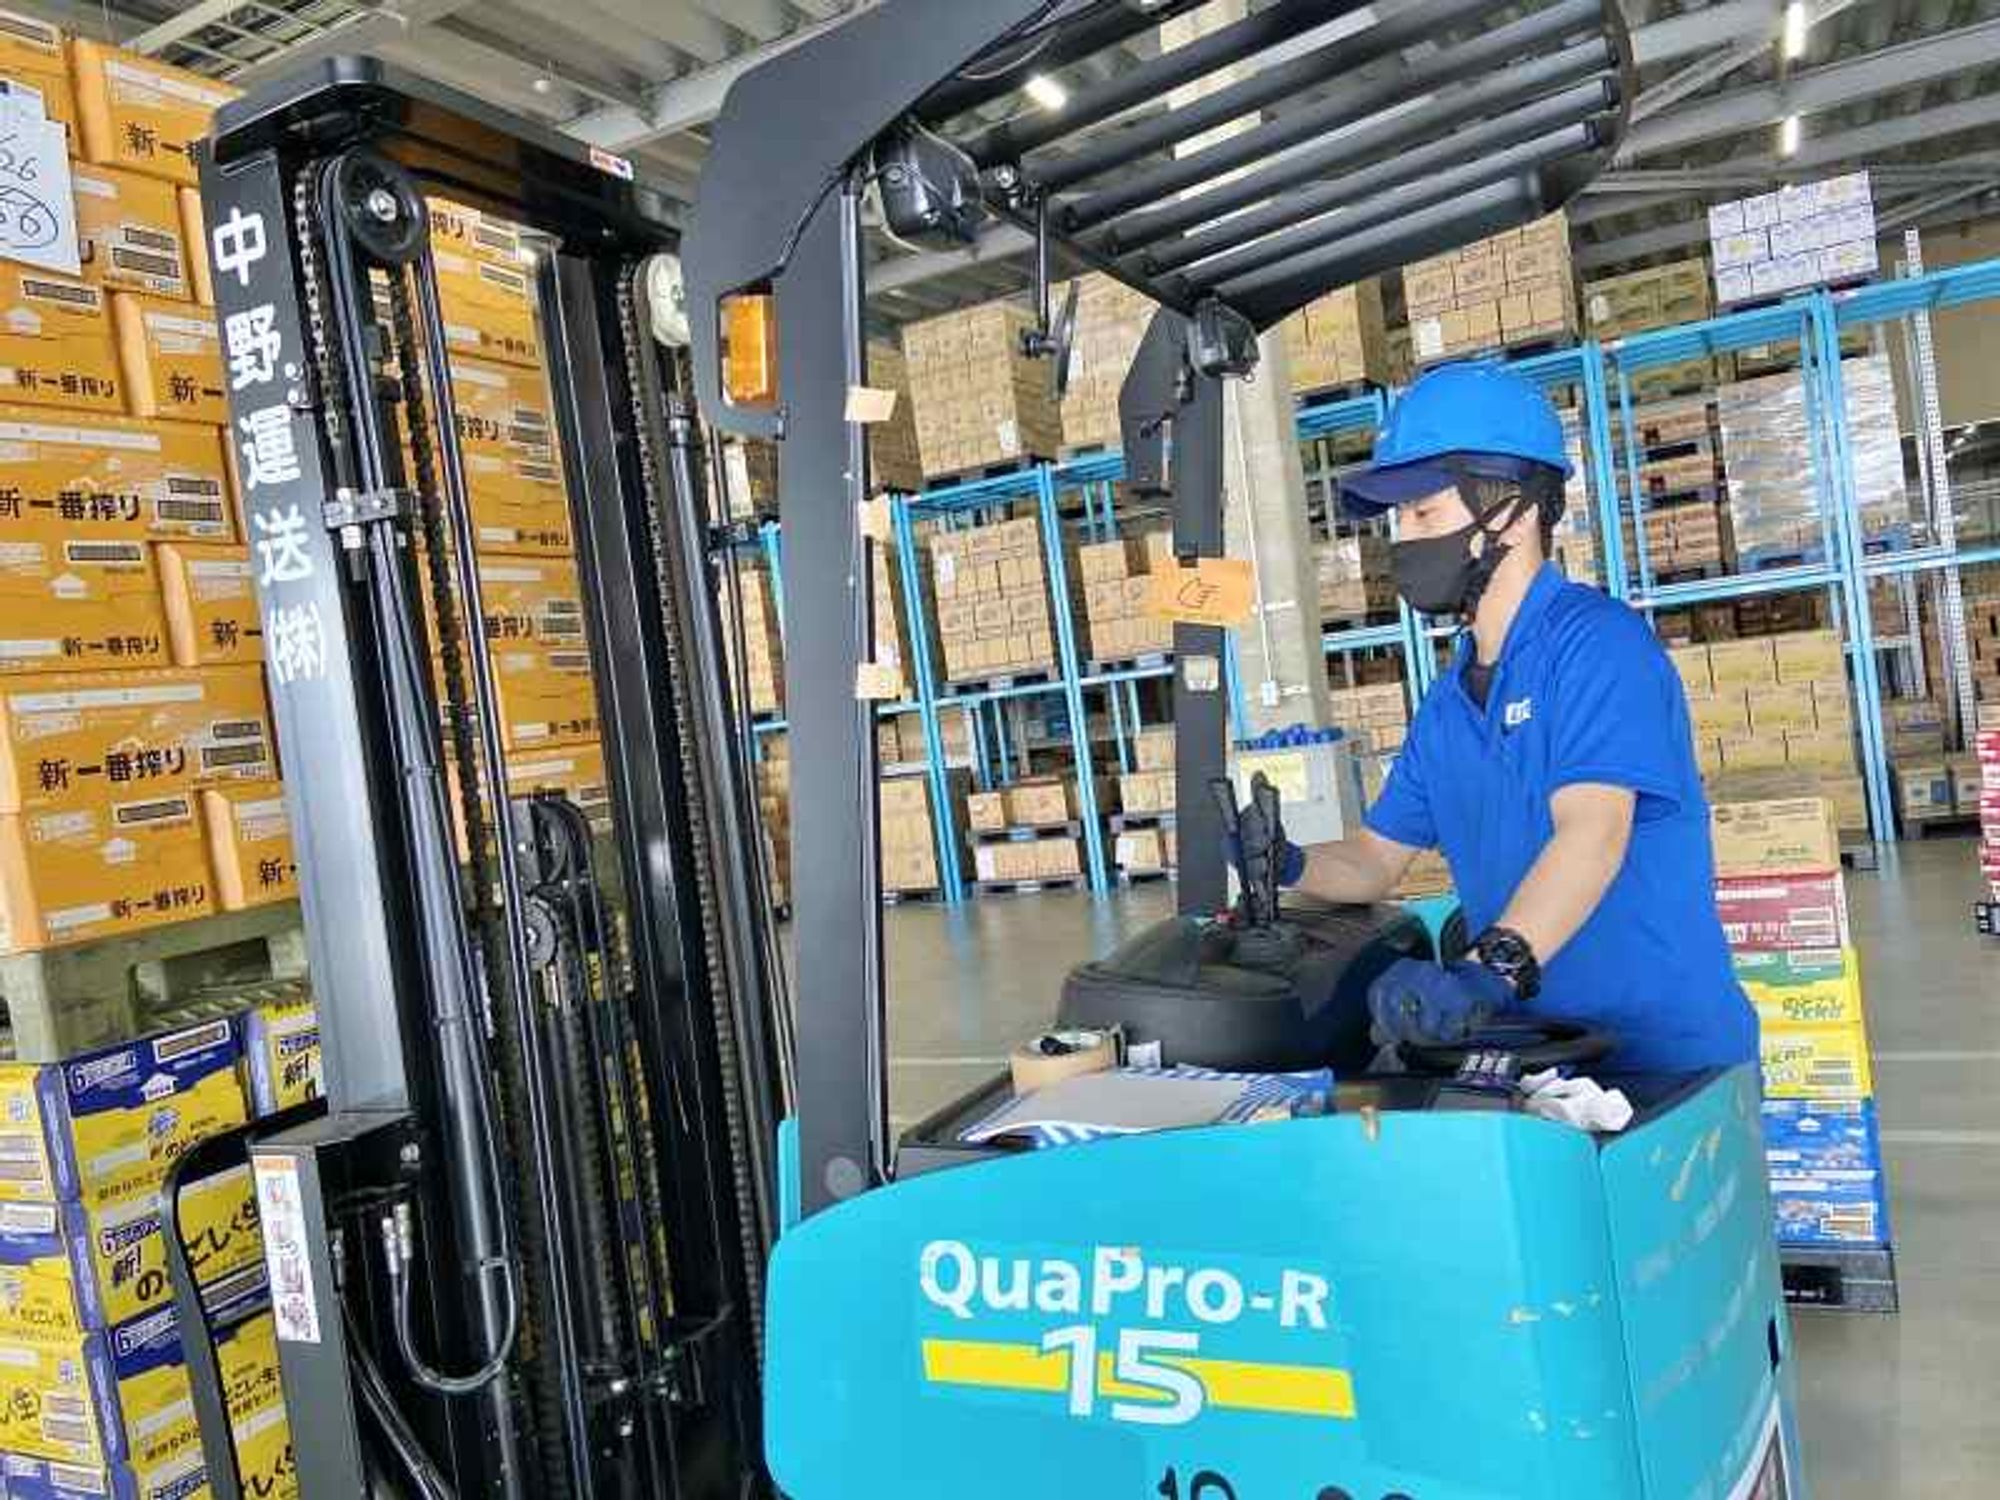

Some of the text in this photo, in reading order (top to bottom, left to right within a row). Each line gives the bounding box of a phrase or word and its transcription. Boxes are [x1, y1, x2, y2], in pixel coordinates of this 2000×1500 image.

[40, 746, 186, 793] 新一番搾り
[920, 1239, 1329, 1329] QuaPro-R
[1040, 1324, 1206, 1425] 15
